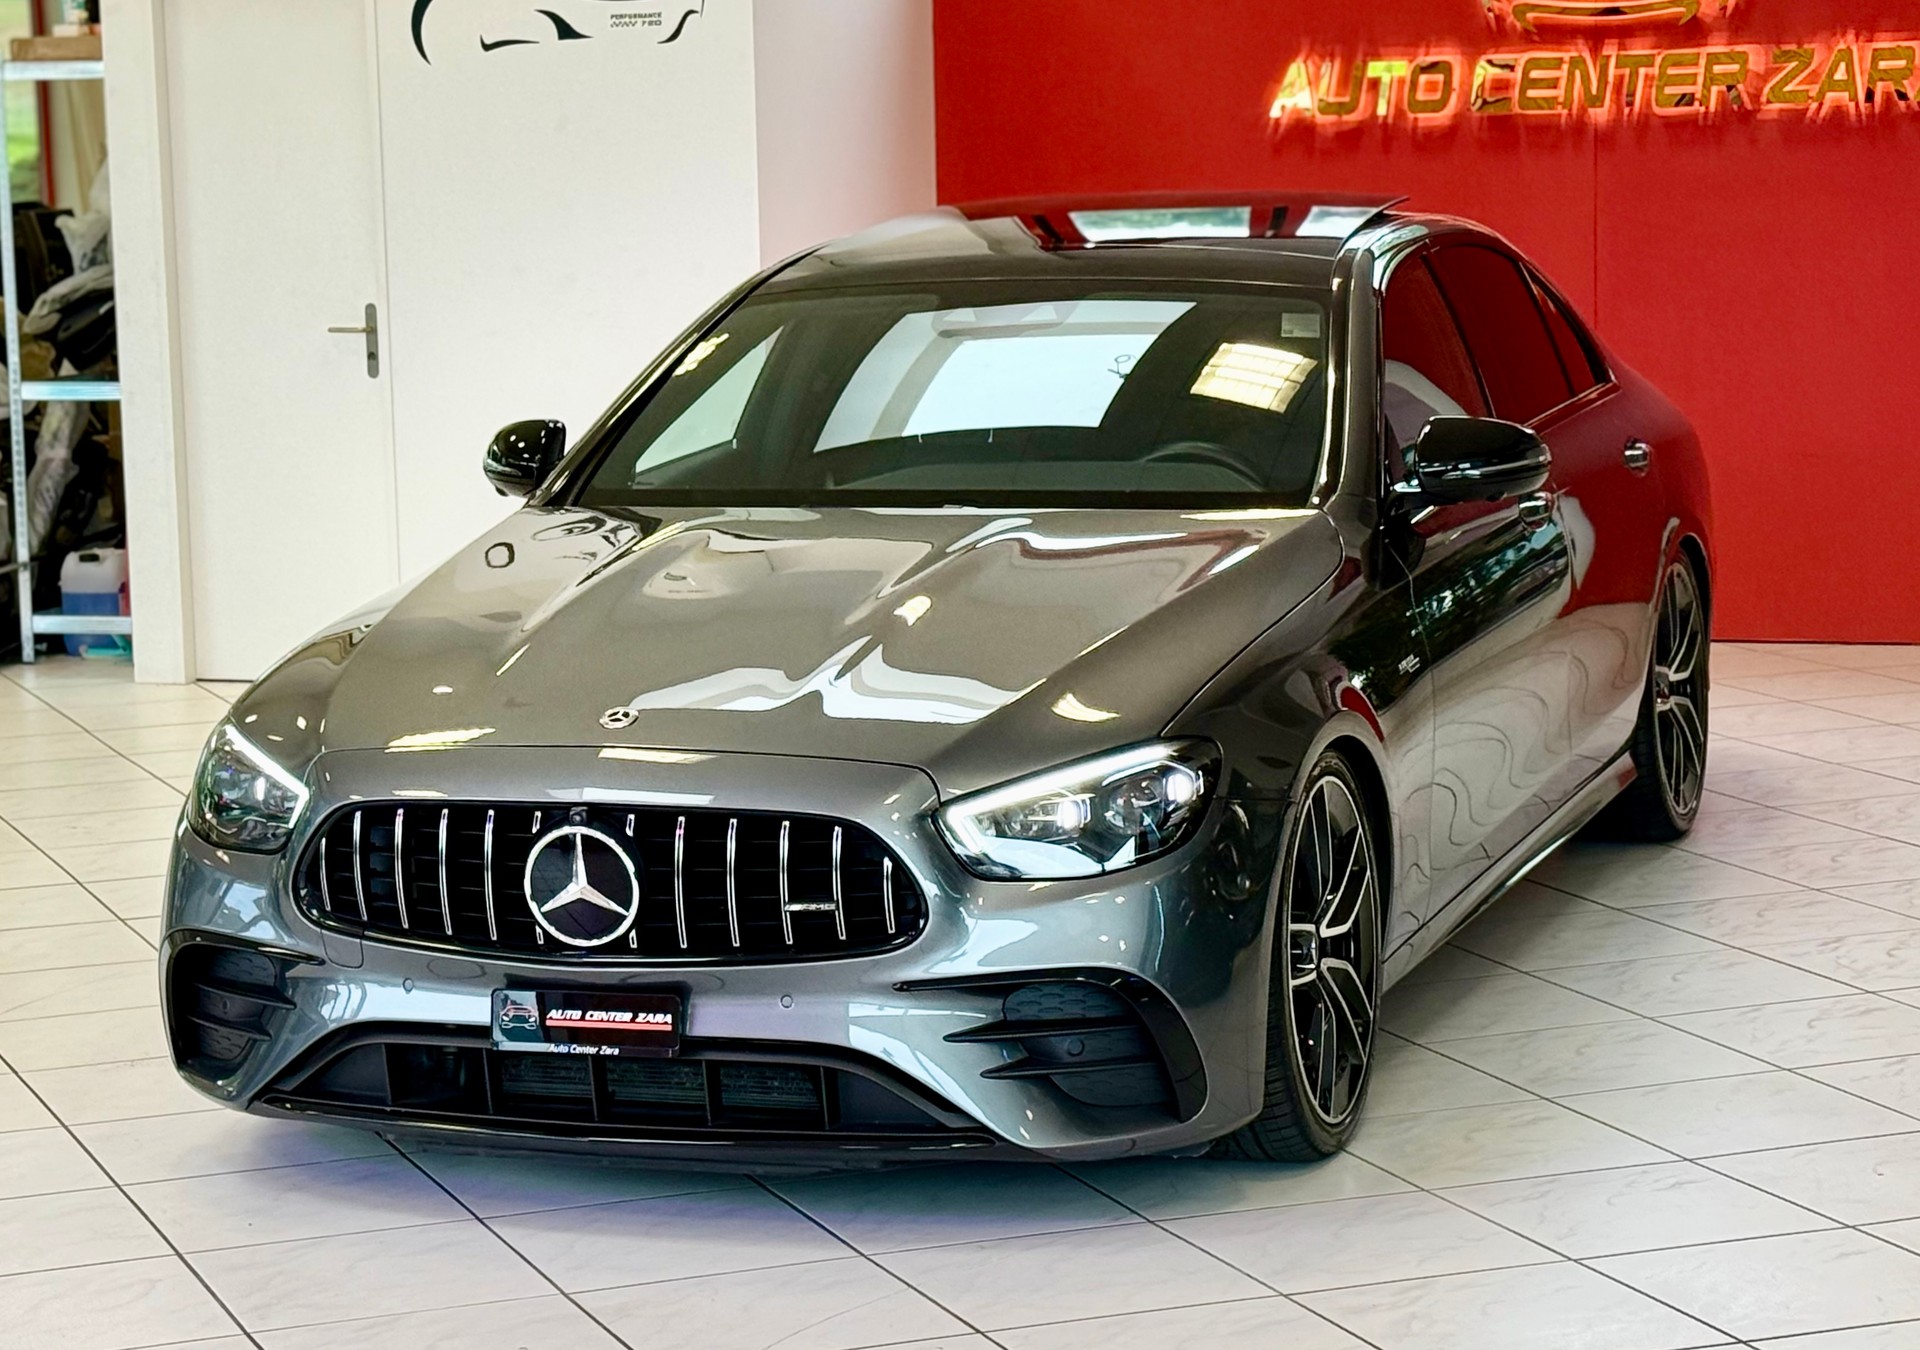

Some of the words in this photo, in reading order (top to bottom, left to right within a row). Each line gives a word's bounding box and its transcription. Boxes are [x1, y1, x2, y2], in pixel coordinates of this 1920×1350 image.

[1268, 58, 1455, 118] AUTO
[1471, 49, 1751, 112] CENTER
[1766, 45, 1920, 103] ZAR
[546, 1009, 583, 1020] AUTO
[585, 1010, 633, 1022] CENTER
[634, 1012, 672, 1024] ZARA
[550, 1043, 570, 1053] Auto
[570, 1044, 599, 1054] Center
[599, 1045, 620, 1055] Zara
